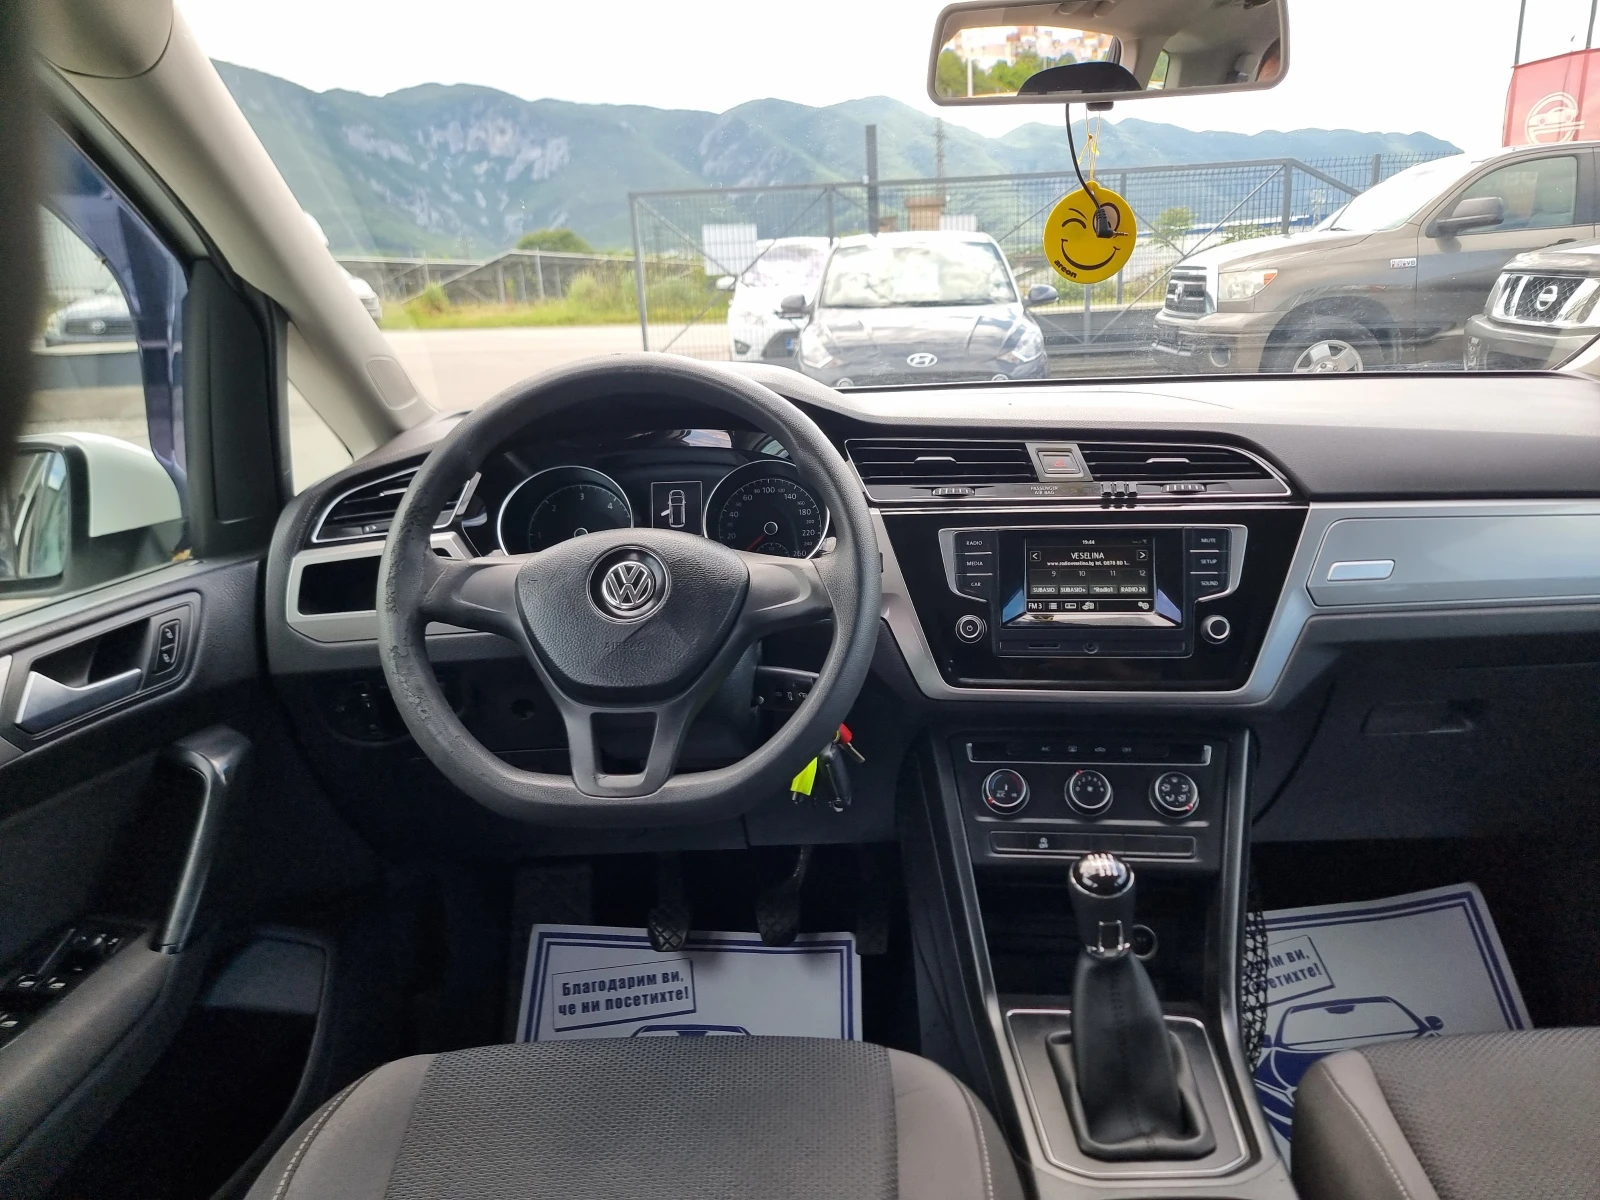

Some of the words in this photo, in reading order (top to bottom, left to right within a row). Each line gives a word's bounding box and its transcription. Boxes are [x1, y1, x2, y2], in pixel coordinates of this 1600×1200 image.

[1054, 260, 1077, 278] areon
[562, 974, 657, 996] Благодарим
[558, 1003, 576, 1016] че
[581, 1000, 600, 1013] ни
[605, 986, 689, 1010] посетихте!
